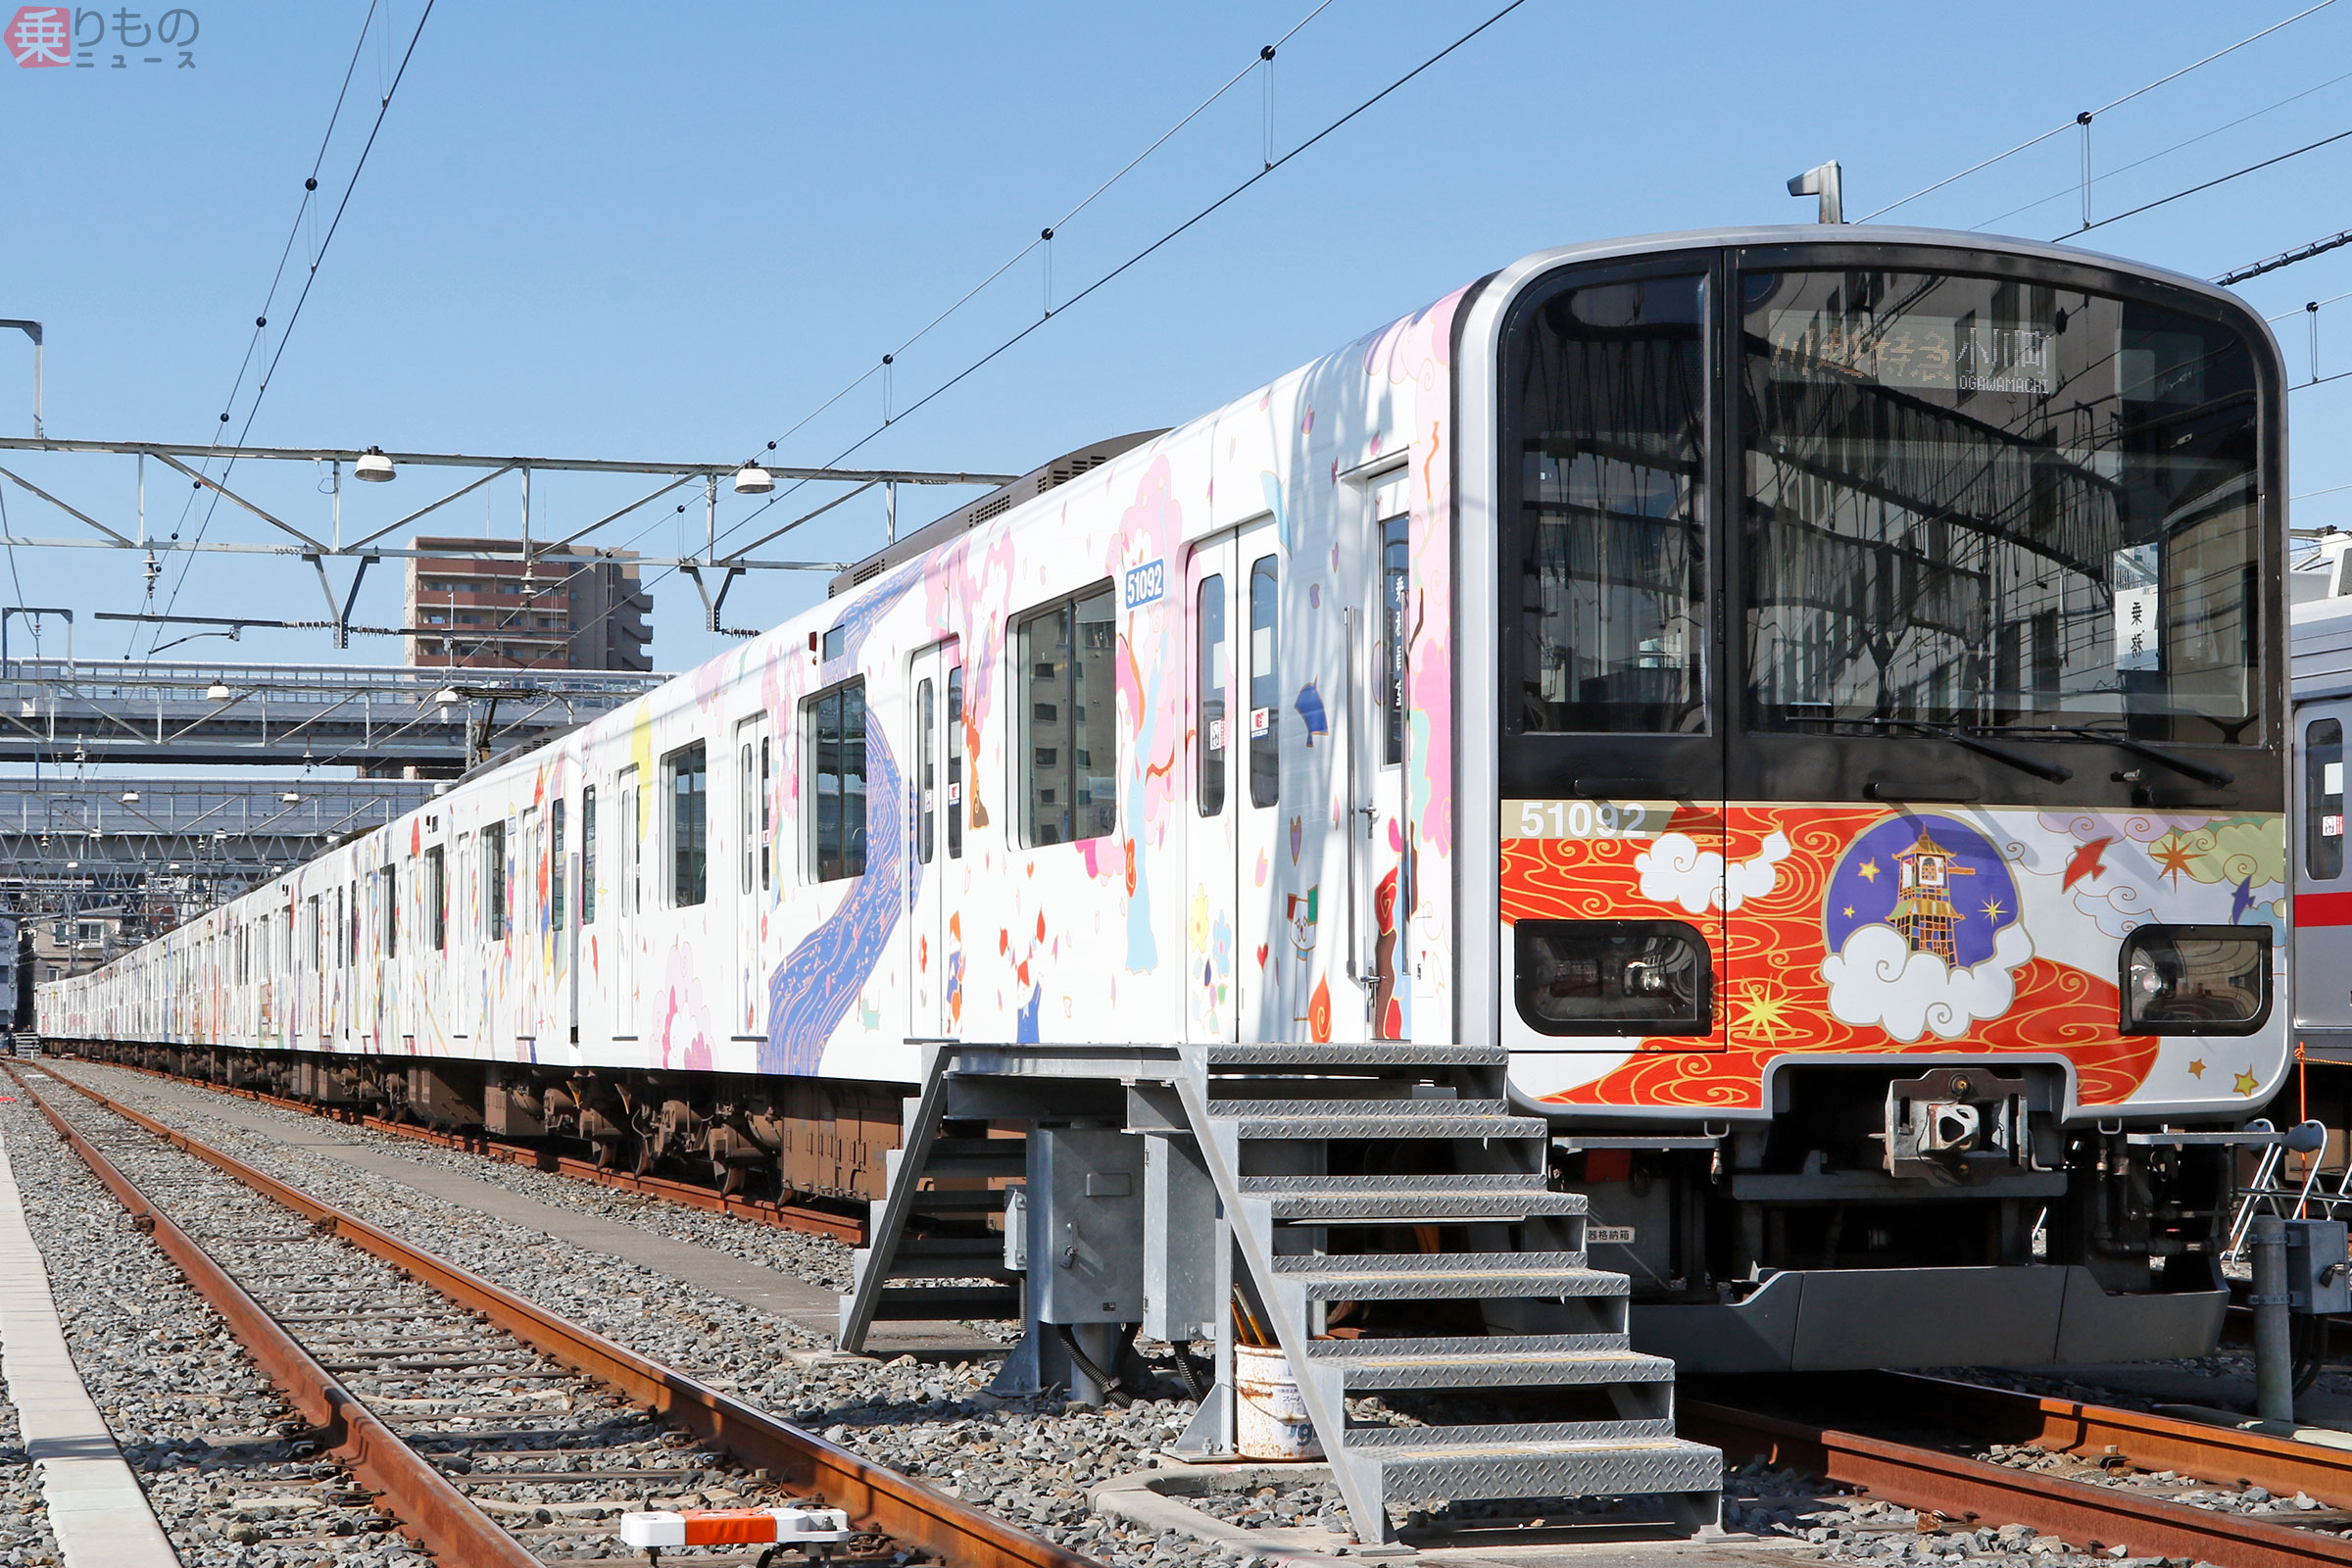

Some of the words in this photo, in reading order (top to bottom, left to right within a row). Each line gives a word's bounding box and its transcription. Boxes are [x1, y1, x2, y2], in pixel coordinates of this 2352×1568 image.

[1956, 327, 2052, 377] 小川町
[1960, 375, 2048, 393] OGAWAMACHI
[1127, 564, 1162, 605] 51092
[1520, 802, 1646, 838] 51092
